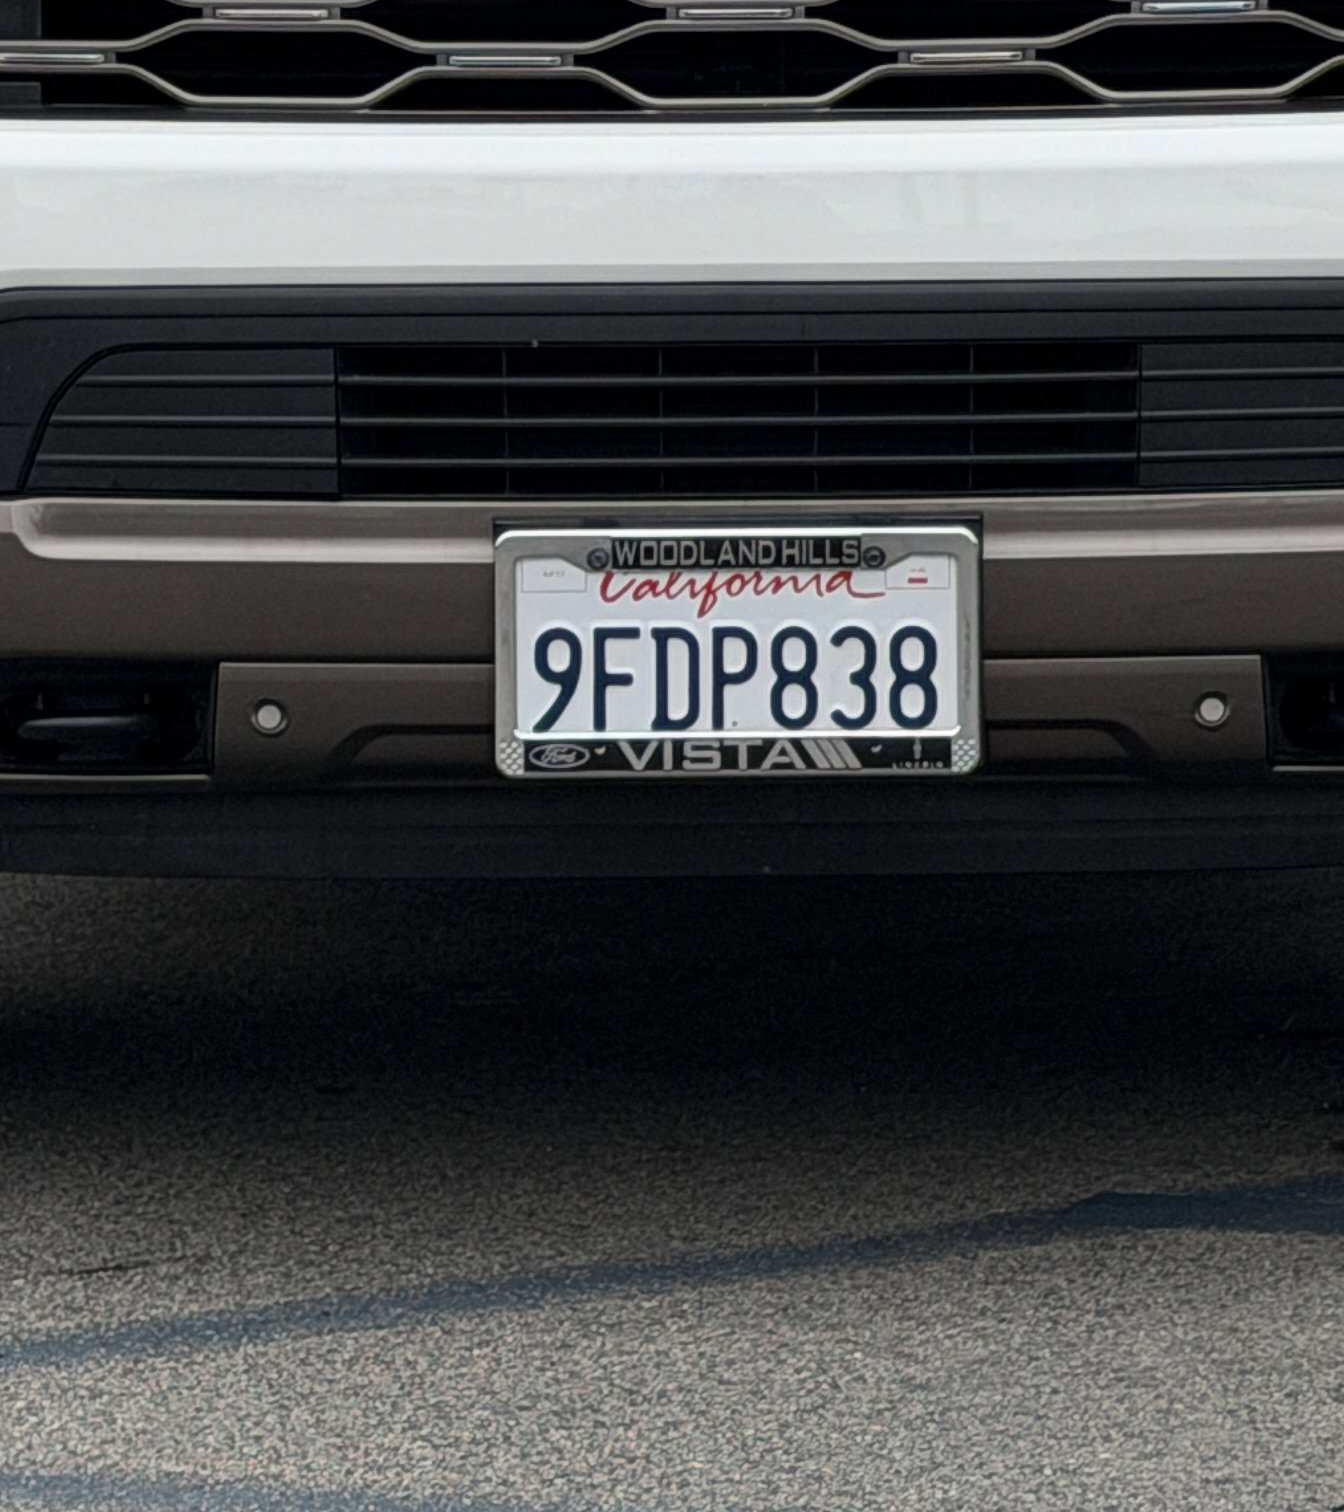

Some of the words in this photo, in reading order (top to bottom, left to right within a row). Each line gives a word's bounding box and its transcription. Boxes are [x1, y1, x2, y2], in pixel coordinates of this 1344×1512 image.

[615, 540, 775, 568] WOODLAND
[781, 539, 860, 565] HILLS
[599, 570, 885, 619] California
[532, 625, 939, 732] 9FDP838
[616, 740, 806, 769] VISTA
